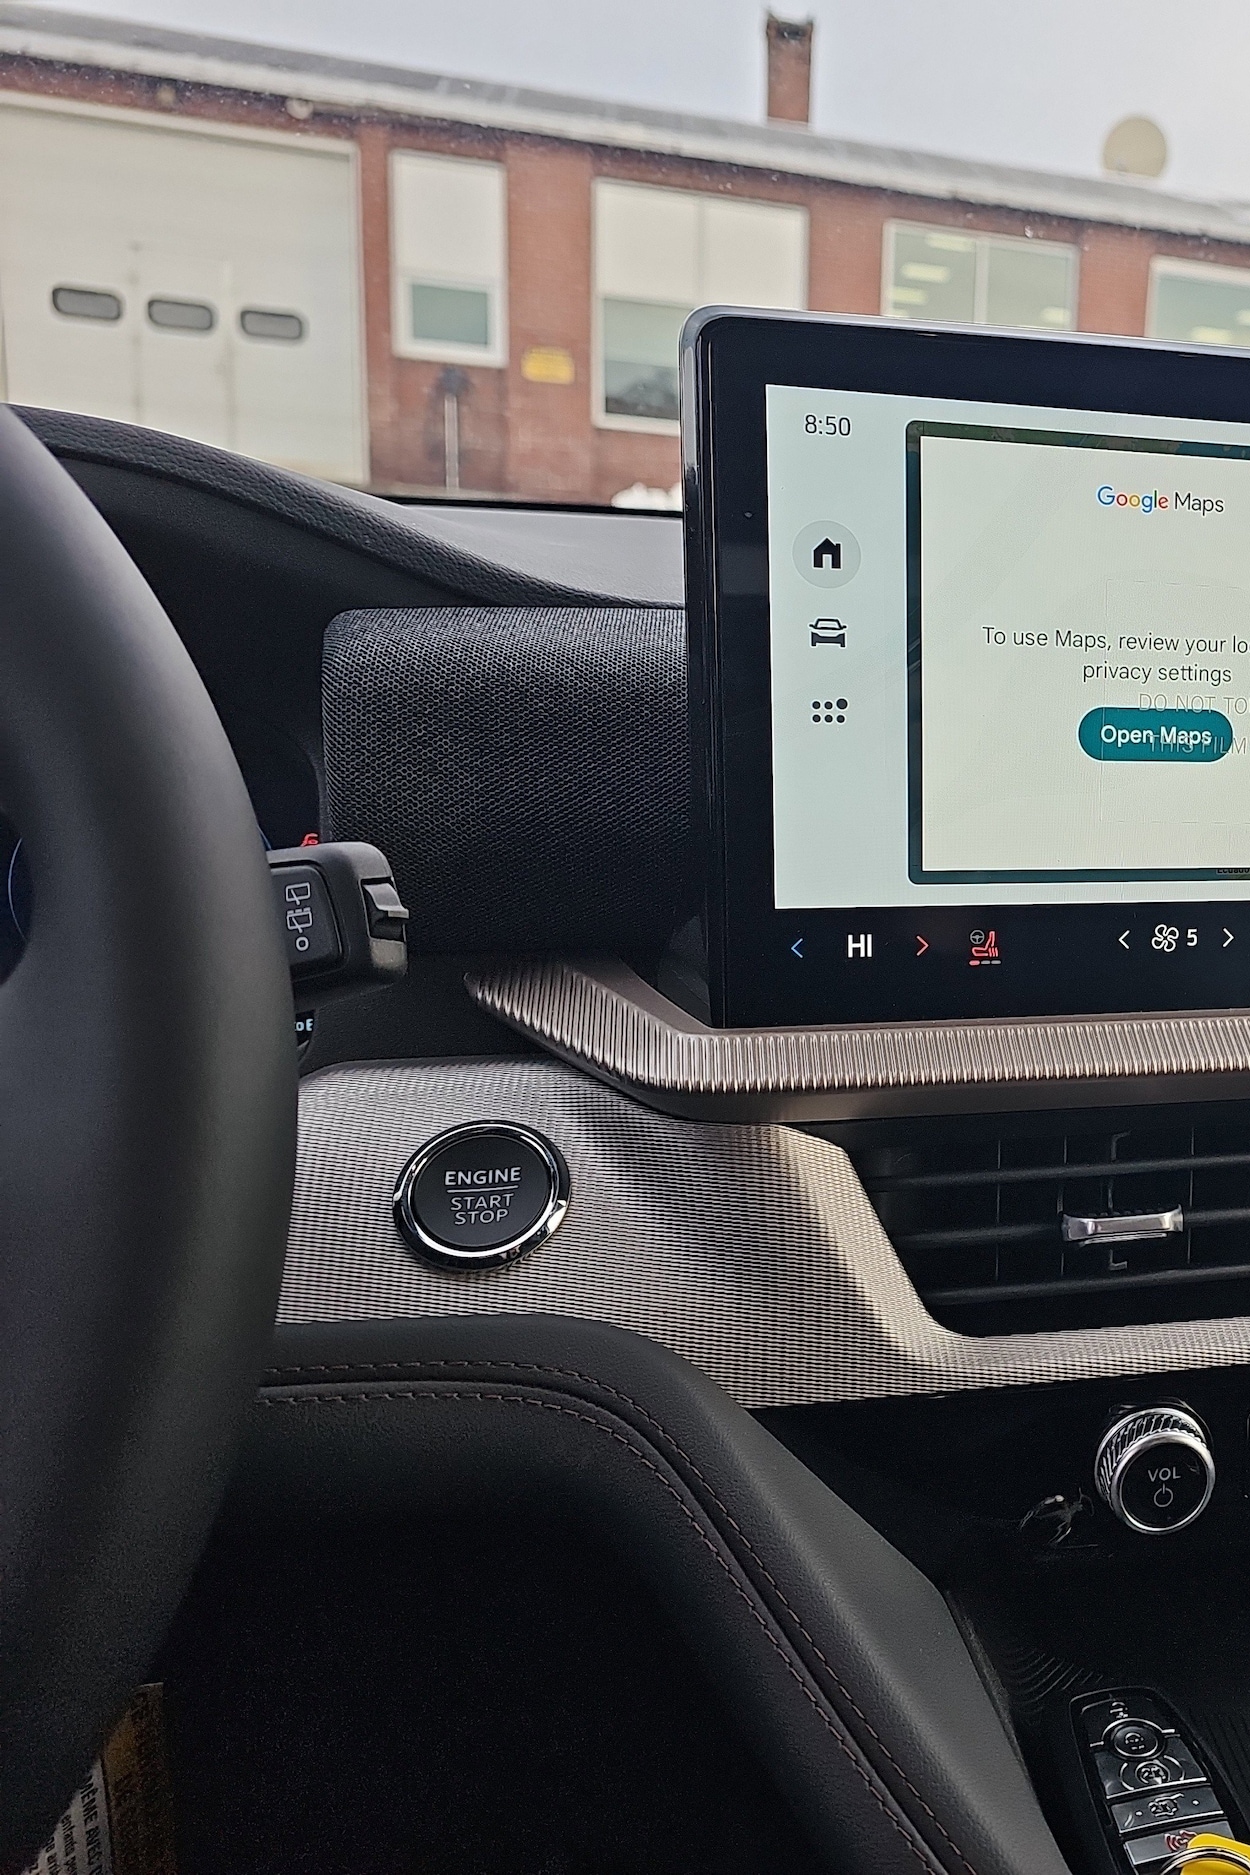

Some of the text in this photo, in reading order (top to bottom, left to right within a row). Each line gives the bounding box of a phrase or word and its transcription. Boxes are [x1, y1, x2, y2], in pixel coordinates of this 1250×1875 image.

[804, 413, 851, 436] 8:50
[1097, 485, 1225, 516] Google Maps
[982, 626, 1006, 646] To
[1013, 631, 1048, 647] use
[1055, 629, 1112, 652] Maps,
[1118, 632, 1180, 652] review
[1185, 637, 1226, 656] your
[1083, 660, 1233, 688] privacy settings
[1138, 693, 1168, 712] DO
[1176, 695, 1216, 714] NOT
[1100, 724, 1213, 748] Open Maps
[1201, 736, 1247, 755] FILM
[847, 934, 873, 959] HI
[1186, 928, 1198, 947] 5
[445, 1167, 521, 1185] ENGINE
[450, 1193, 515, 1210] START
[455, 1209, 509, 1225] STOP
[1147, 1466, 1182, 1482] VOL
